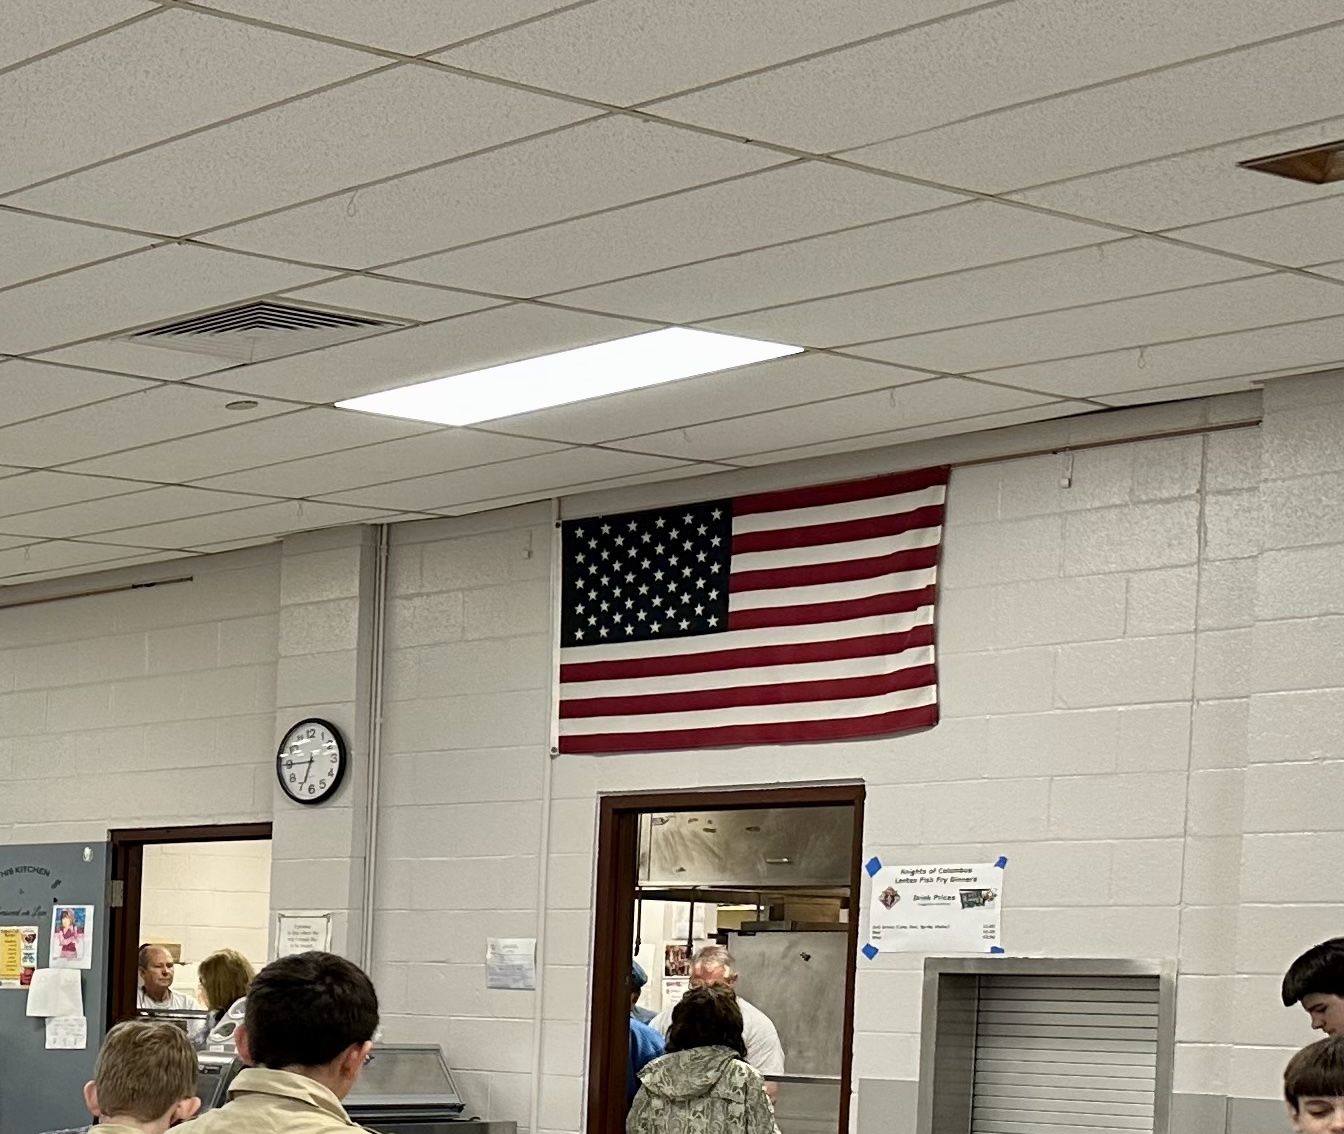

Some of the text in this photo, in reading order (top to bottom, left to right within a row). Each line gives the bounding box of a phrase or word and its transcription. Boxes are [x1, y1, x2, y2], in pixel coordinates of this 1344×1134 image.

[306, 728, 316, 739] 12
[330, 753, 338, 763] 3
[289, 773, 297, 783] 8
[327, 768, 335, 778] 4
[298, 782, 305, 792] 7
[308, 784, 316, 795] 6
[318, 779, 327, 790] 5
[14, 865, 51, 877] KITCHEN
[900, 867, 973, 877] Knights of Columbus
[895, 877, 918, 885] Lenten
[919, 876, 933, 884] Fish
[935, 876, 949, 885] Fry
[913, 894, 931, 902] Drink
